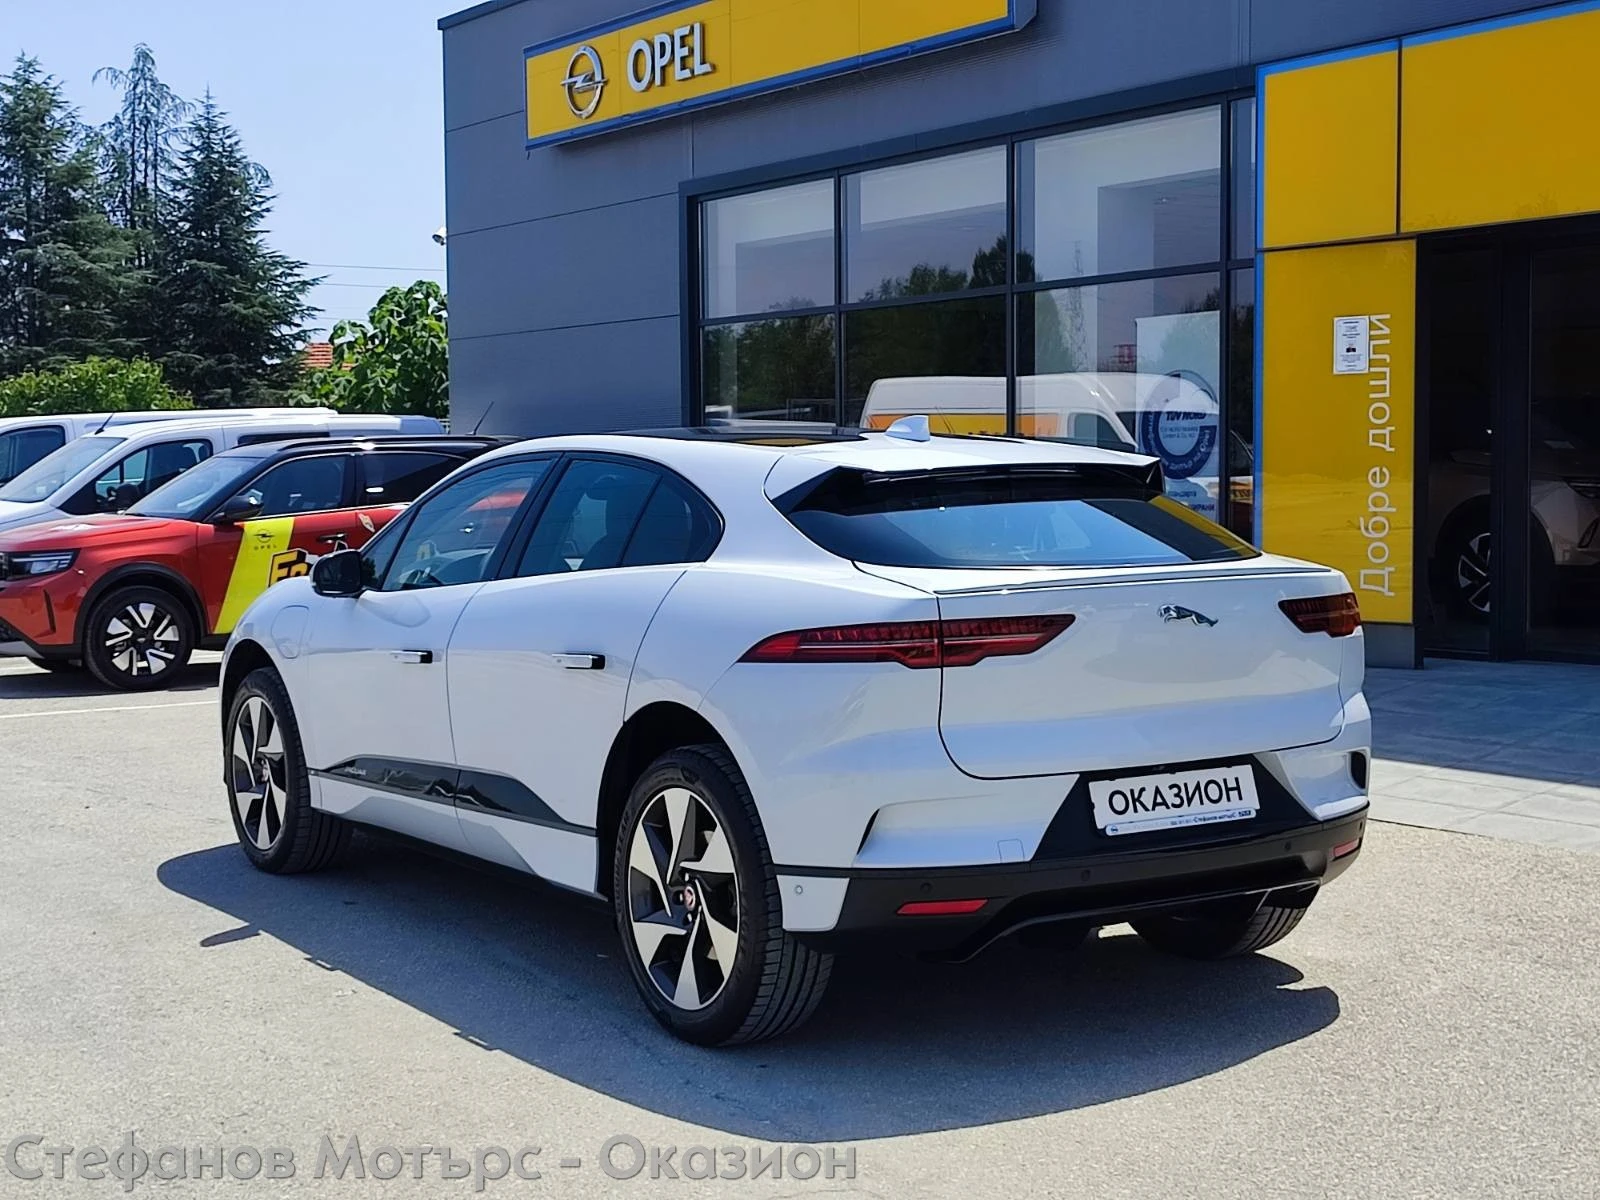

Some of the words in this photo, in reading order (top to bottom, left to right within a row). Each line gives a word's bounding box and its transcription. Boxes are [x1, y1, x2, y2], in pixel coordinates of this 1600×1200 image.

[627, 22, 714, 92] OPEL
[1368, 313, 1396, 452] дошли
[1359, 466, 1397, 596] Добре
[1108, 776, 1243, 816] ОКАЗИОН
